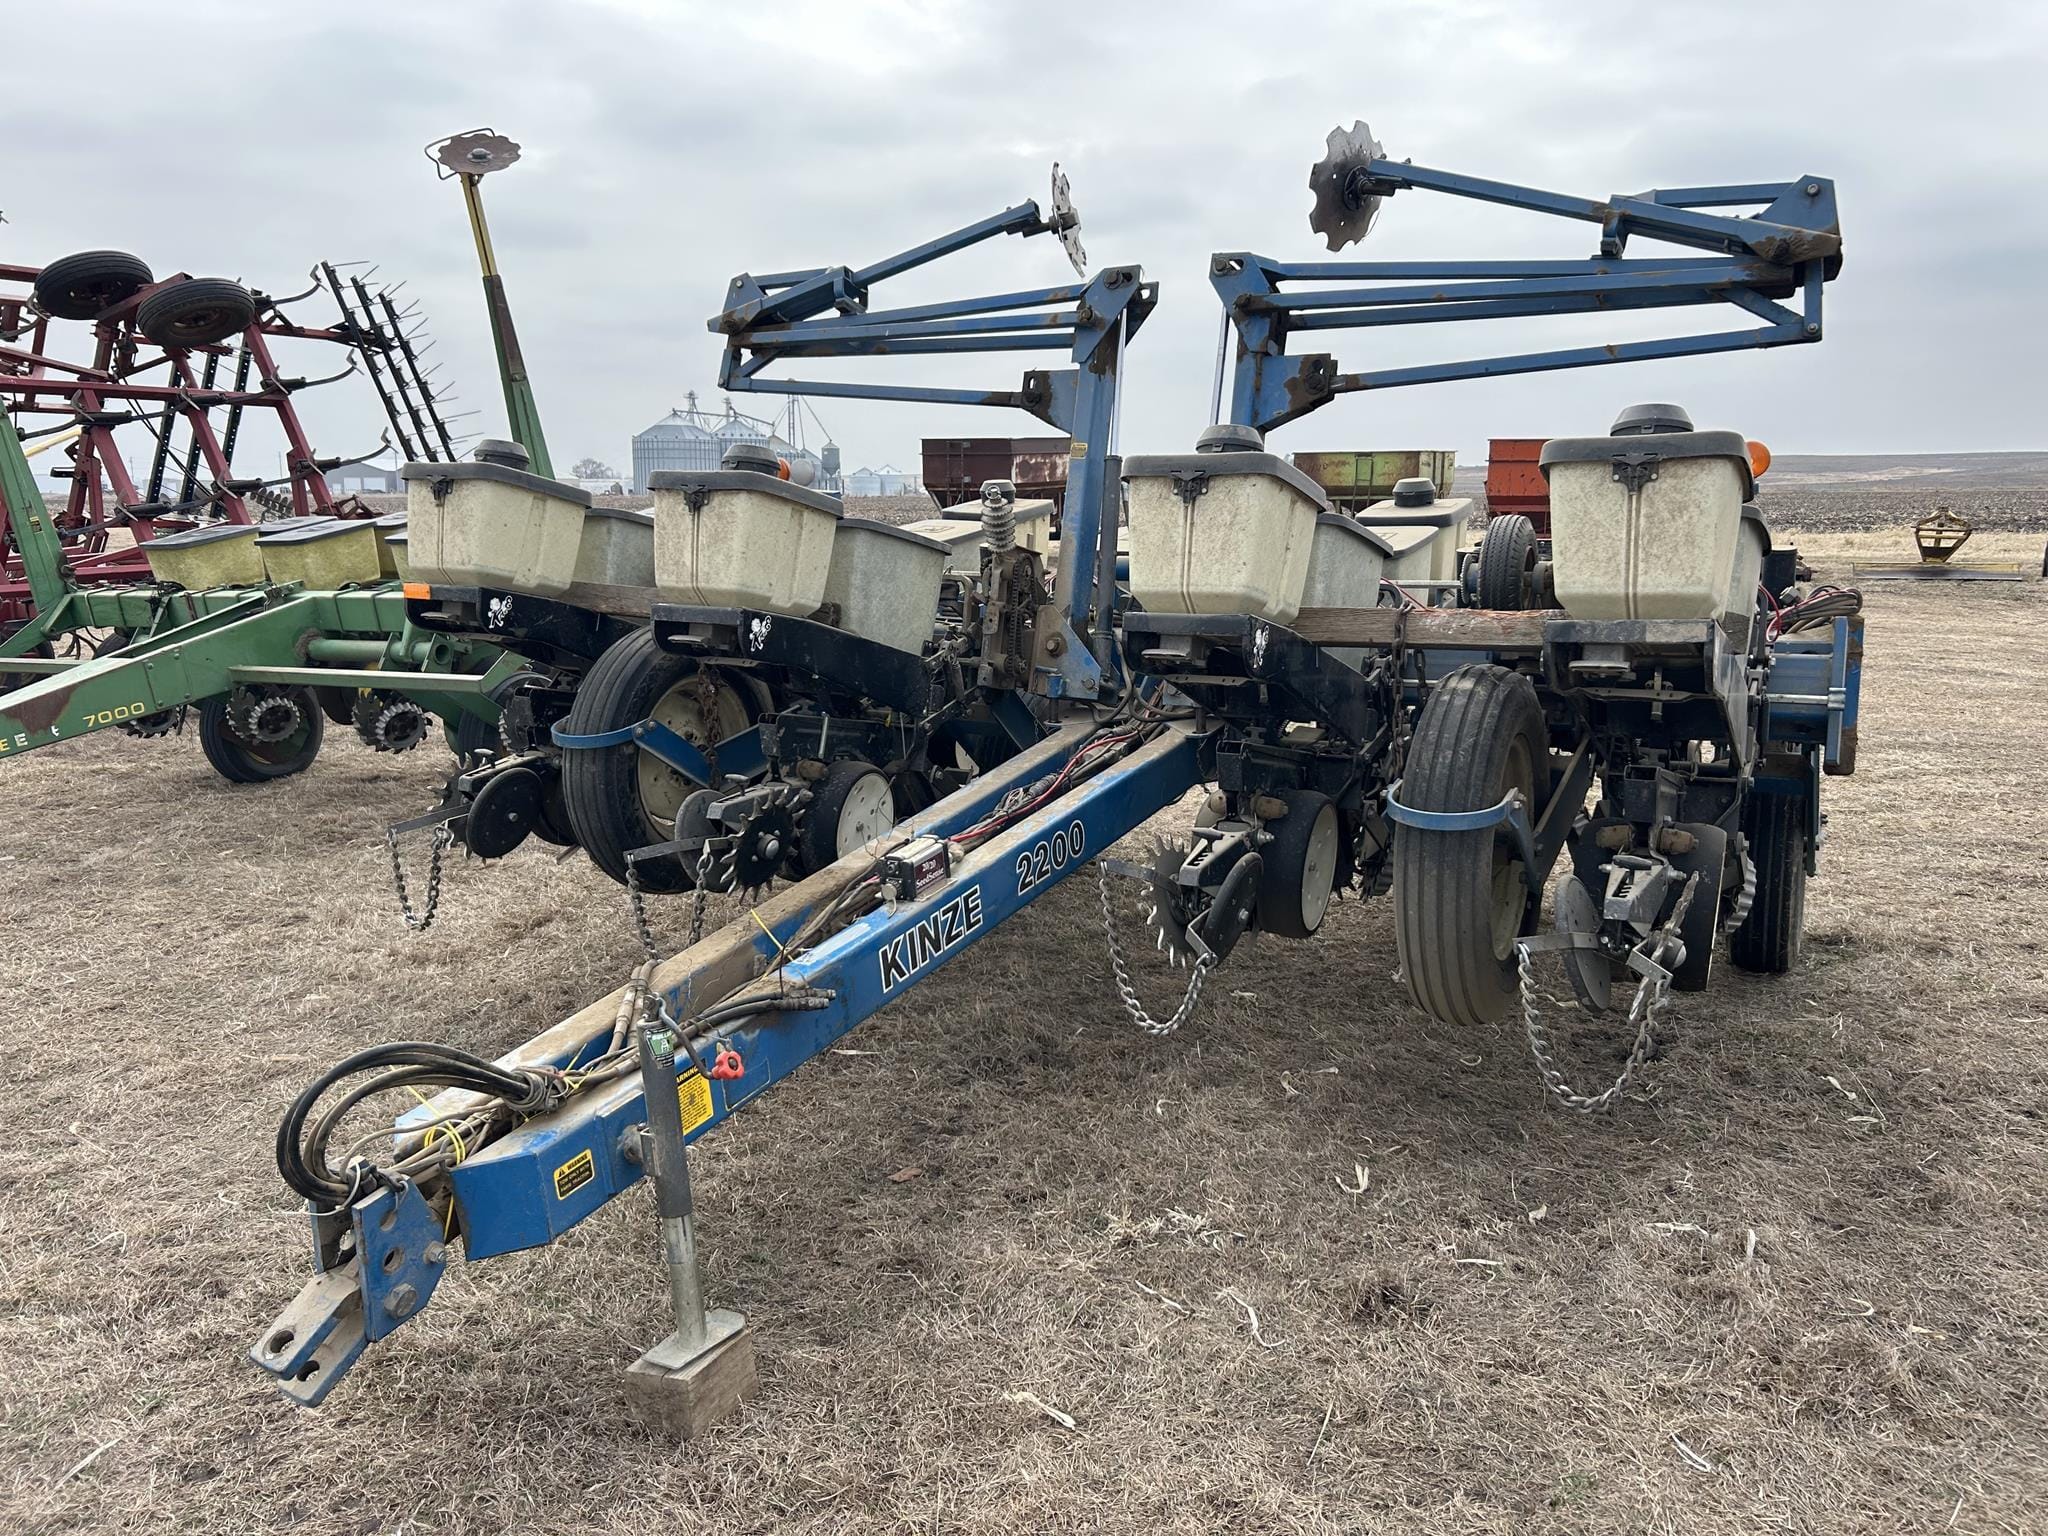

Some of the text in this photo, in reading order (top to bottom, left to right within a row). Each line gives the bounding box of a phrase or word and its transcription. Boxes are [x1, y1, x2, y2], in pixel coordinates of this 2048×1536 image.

[82, 702, 146, 728] 7000
[915, 867, 945, 889] SeedSense
[878, 819, 1086, 994] KINZE 2200
[676, 1065, 699, 1084] ARNING
